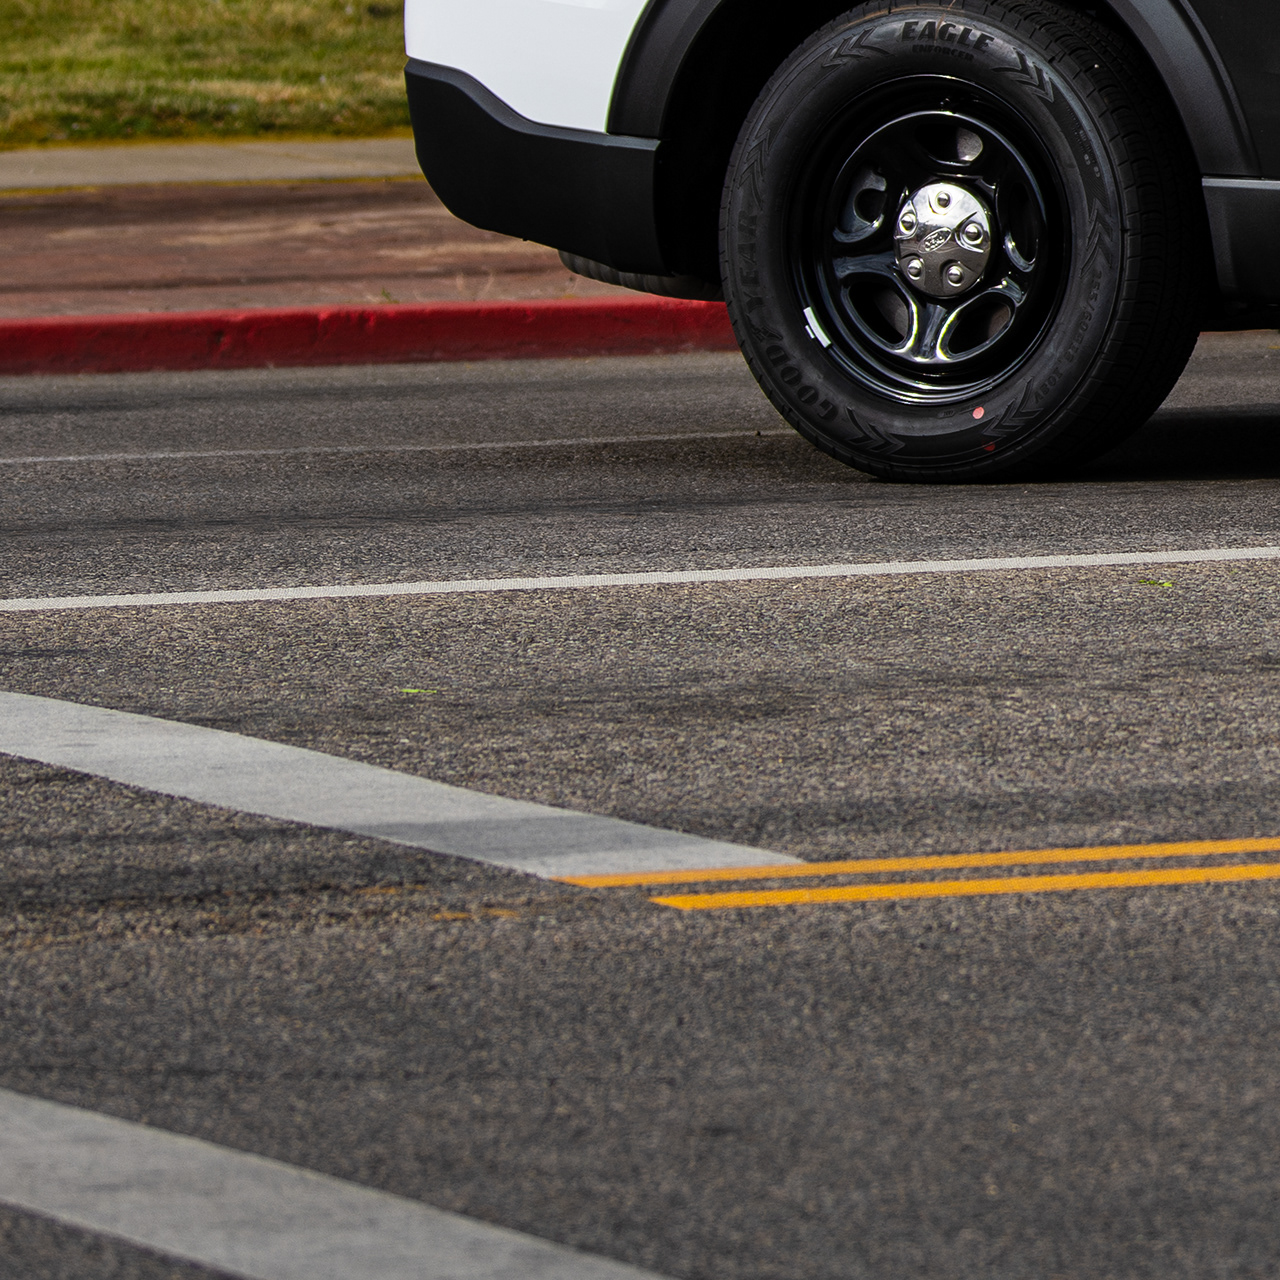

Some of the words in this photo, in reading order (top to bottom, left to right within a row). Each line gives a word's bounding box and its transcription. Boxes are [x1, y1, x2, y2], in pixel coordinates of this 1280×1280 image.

[901, 20, 995, 53] EAGLE
[911, 44, 974, 61] ENFORCER
[737, 209, 839, 422] GOODYEAR
